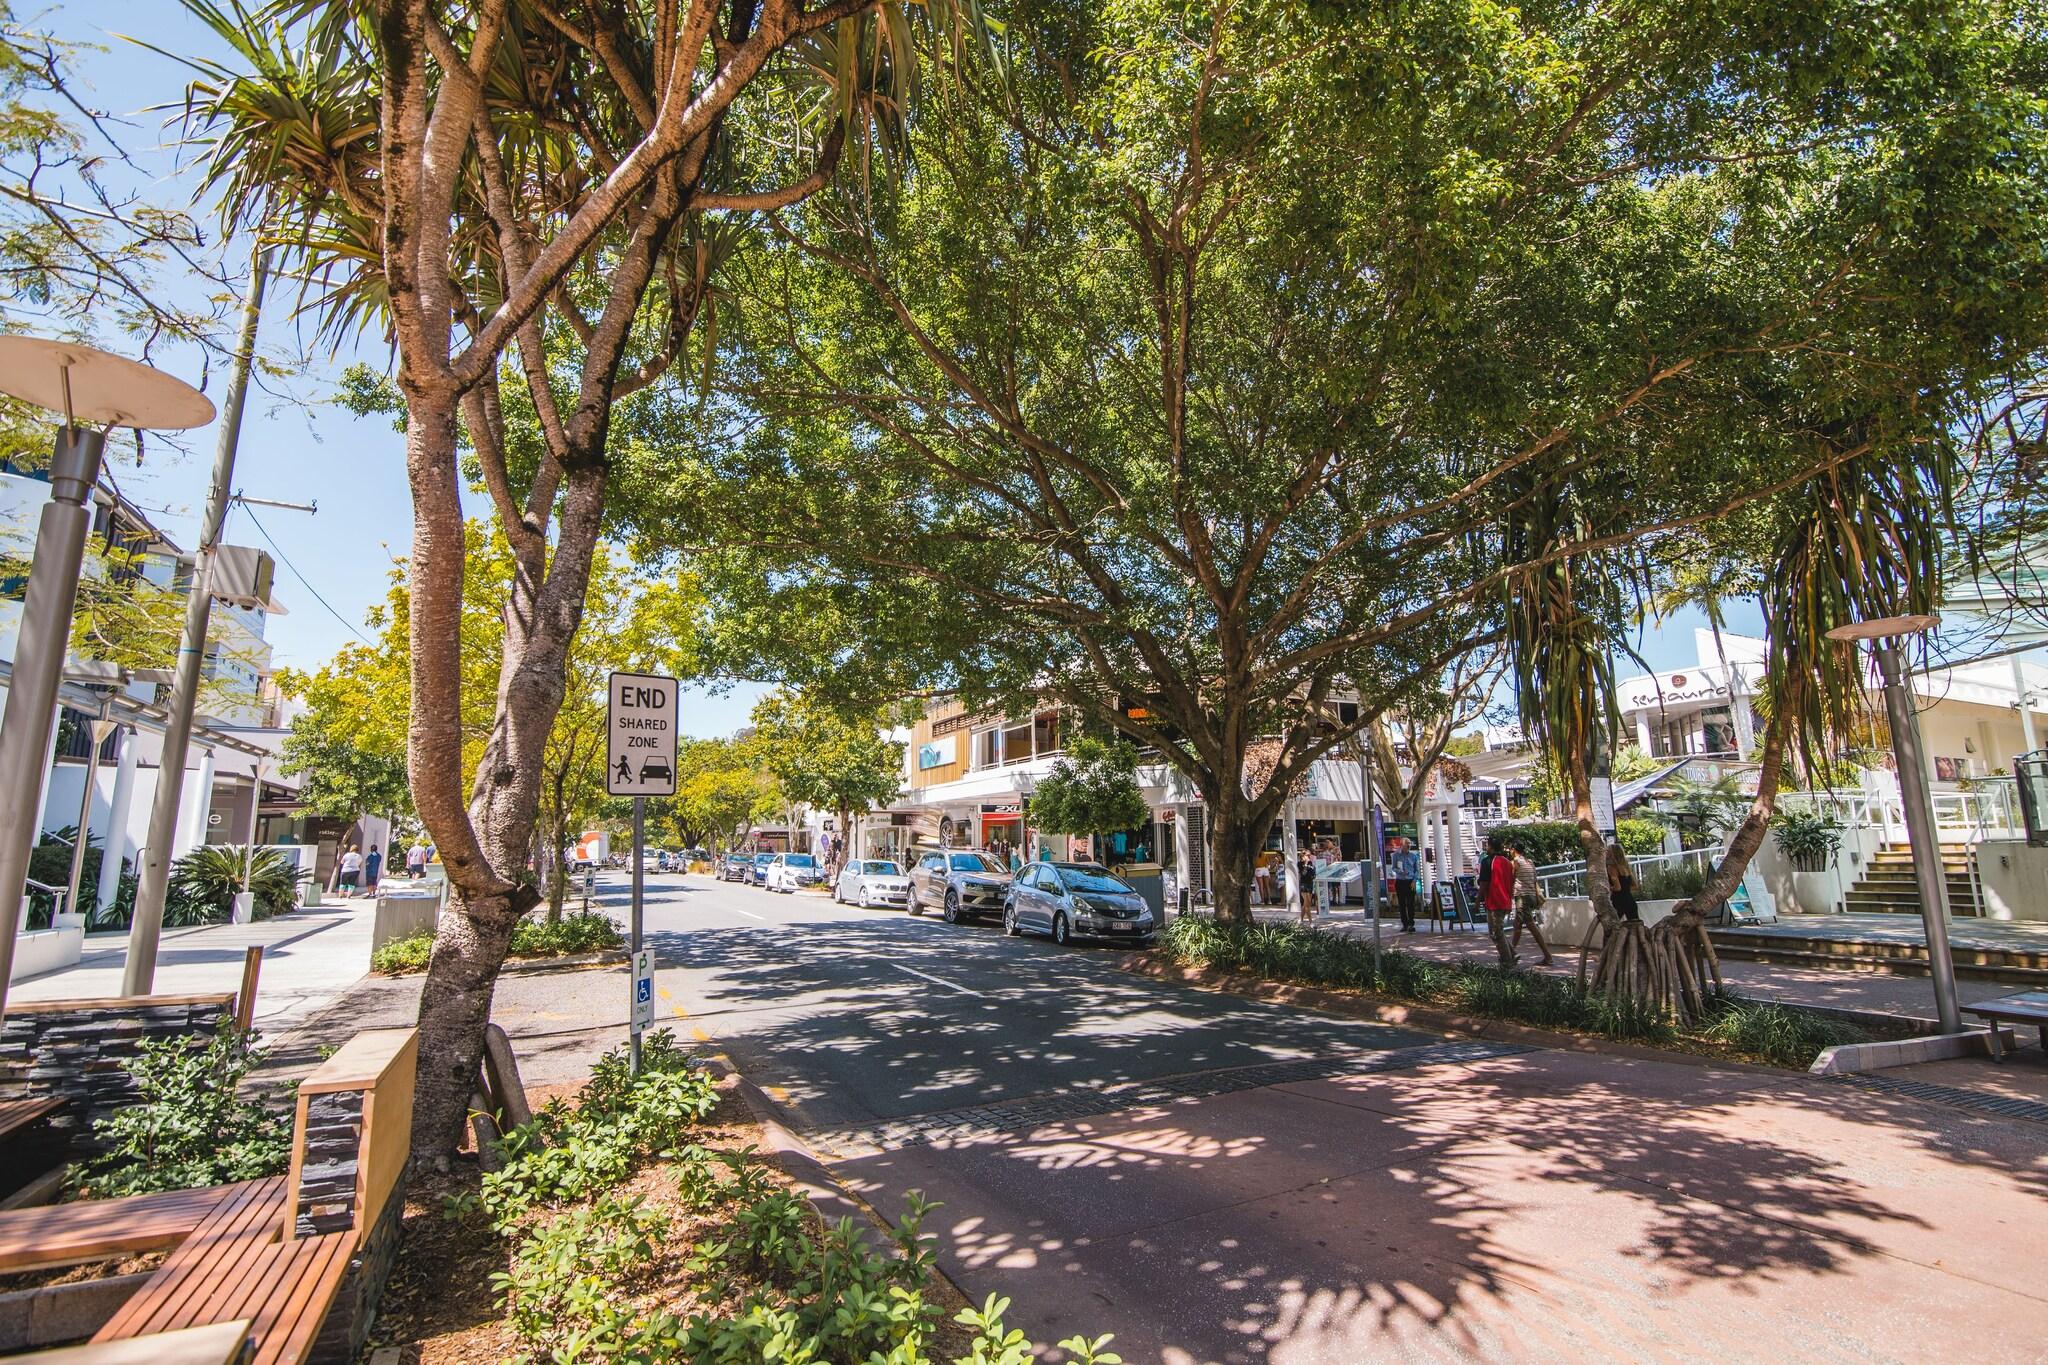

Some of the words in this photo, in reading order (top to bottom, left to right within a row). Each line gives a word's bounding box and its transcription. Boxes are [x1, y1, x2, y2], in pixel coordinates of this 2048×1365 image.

[621, 686, 666, 709] END
[619, 717, 667, 731] SHARED
[627, 736, 659, 748] ZONE
[639, 957, 648, 977] P
[636, 1005, 648, 1015] ONLY
